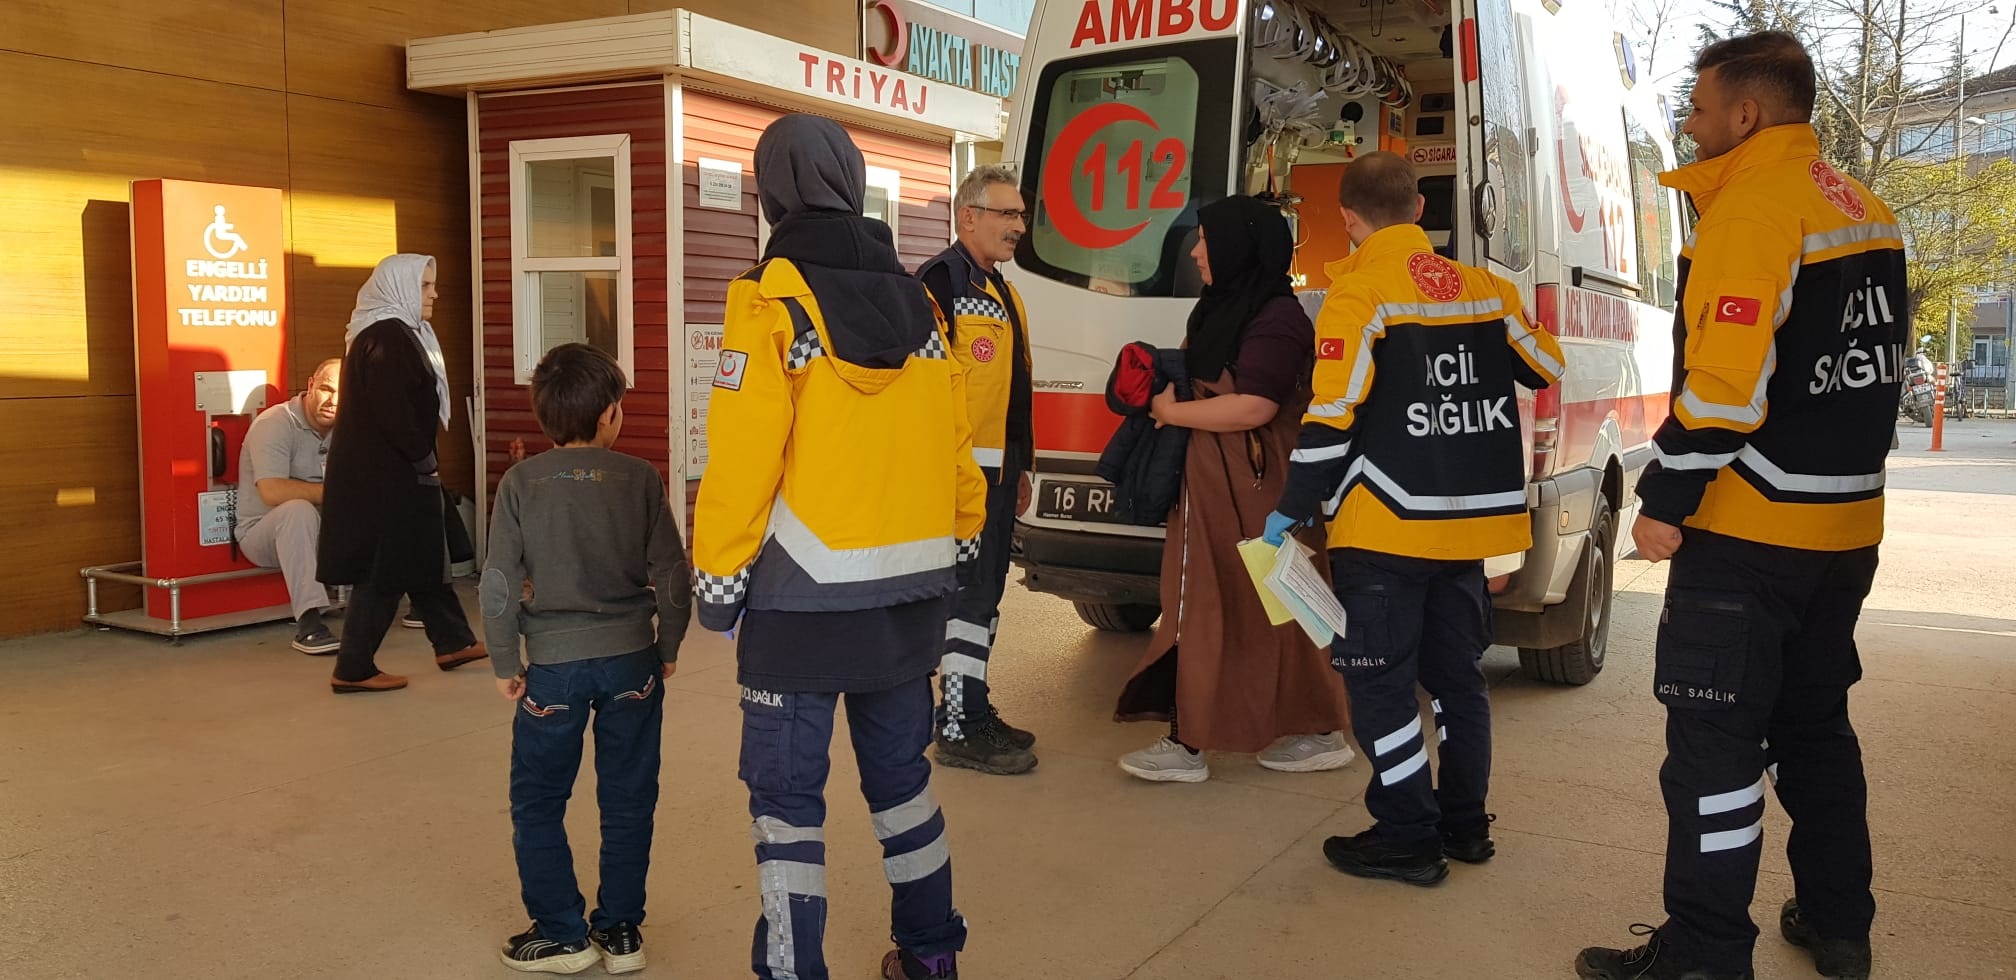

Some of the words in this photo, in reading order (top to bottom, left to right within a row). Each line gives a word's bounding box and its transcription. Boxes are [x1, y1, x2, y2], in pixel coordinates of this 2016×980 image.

[1070, 0, 1238, 49] AMBU
[907, 22, 973, 89] AYAKTA
[1082, 136, 1188, 212] 112
[185, 258, 269, 280] ENGELLİ
[187, 284, 268, 303] YARDIM
[1840, 277, 1895, 334] ACİL
[177, 308, 277, 327] TELEFONU
[1425, 343, 1479, 387] ACİL
[1406, 393, 1514, 437] SAĞLIK
[1054, 486, 1075, 511] 16
[1351, 656, 1386, 667] SAĞLIK
[752, 688, 783, 708] SAĞLIK
[1688, 687, 1736, 703] SAĞLIK
